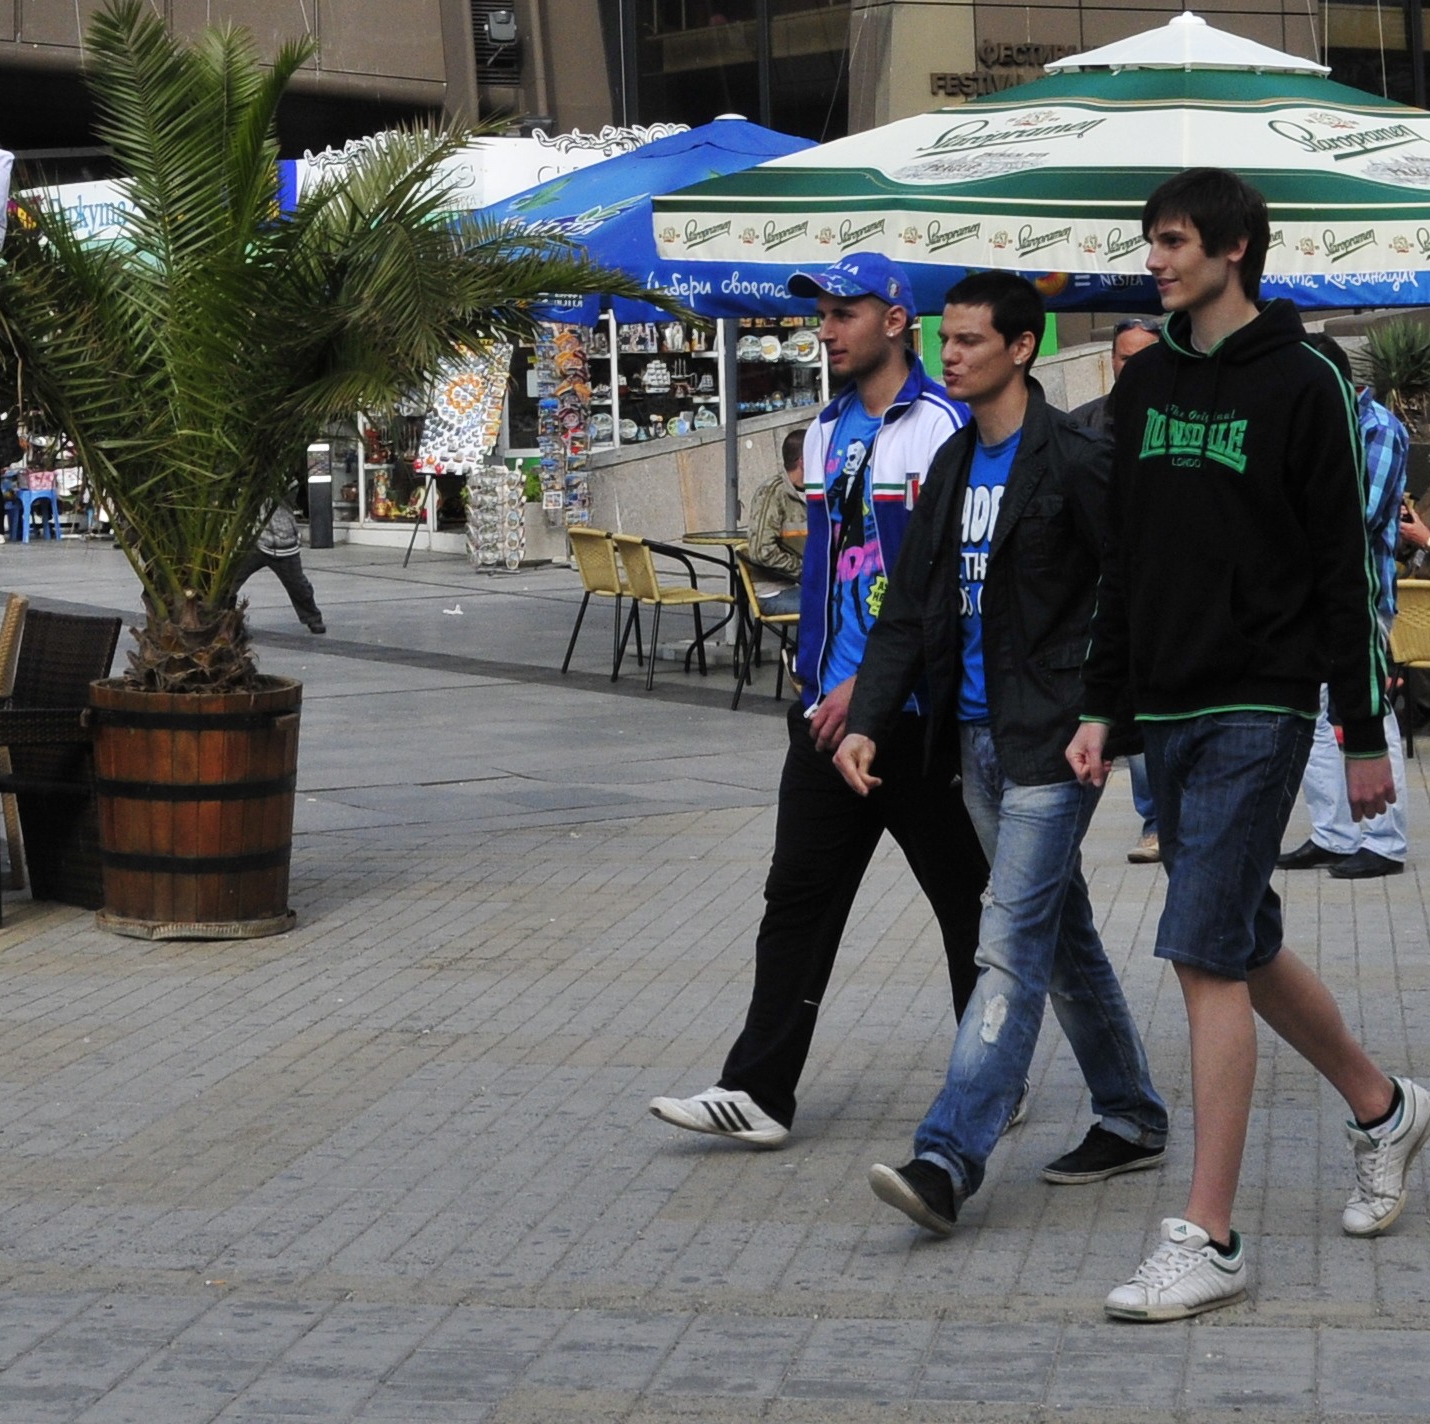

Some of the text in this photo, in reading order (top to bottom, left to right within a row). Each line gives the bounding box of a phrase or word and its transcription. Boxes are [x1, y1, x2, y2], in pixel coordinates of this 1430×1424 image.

[911, 119, 1107, 159] Staropramen
[721, 270, 792, 300] своята
[1100, 273, 1144, 287] NESTEA
[1171, 456, 1202, 468] LONDO
